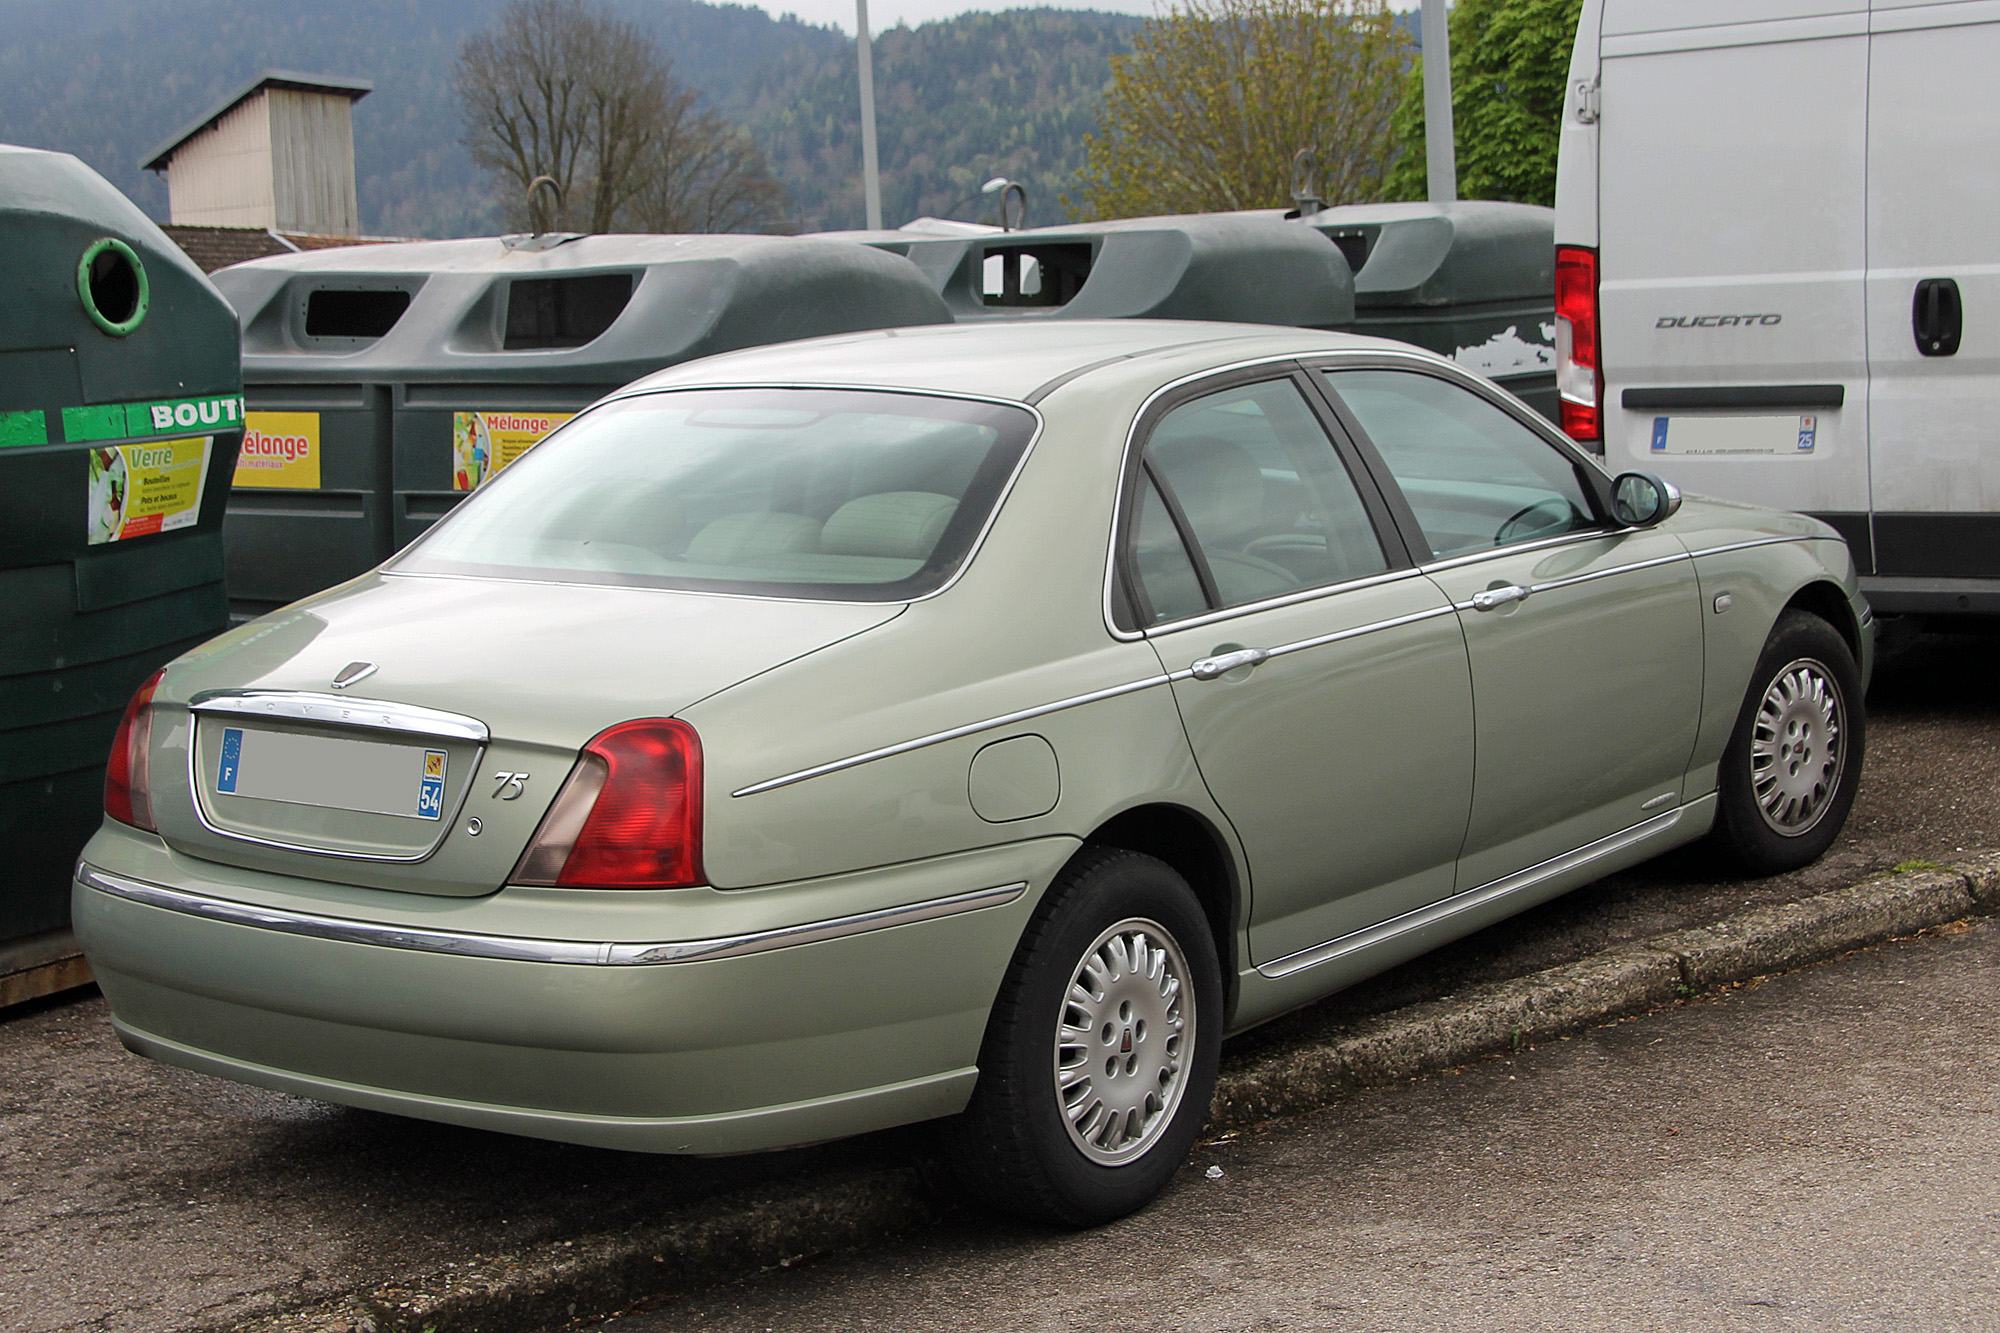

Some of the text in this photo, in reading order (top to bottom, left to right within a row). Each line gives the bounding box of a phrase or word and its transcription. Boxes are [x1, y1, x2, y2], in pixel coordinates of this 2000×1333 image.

[1655, 314, 1782, 329] DUCATO
[487, 415, 549, 435] Mélange
[240, 430, 309, 462] élange
[1798, 433, 1813, 448] 25
[131, 448, 173, 469] Verre
[224, 767, 232, 782] F
[491, 770, 530, 801] 75
[420, 785, 440, 811] 54
